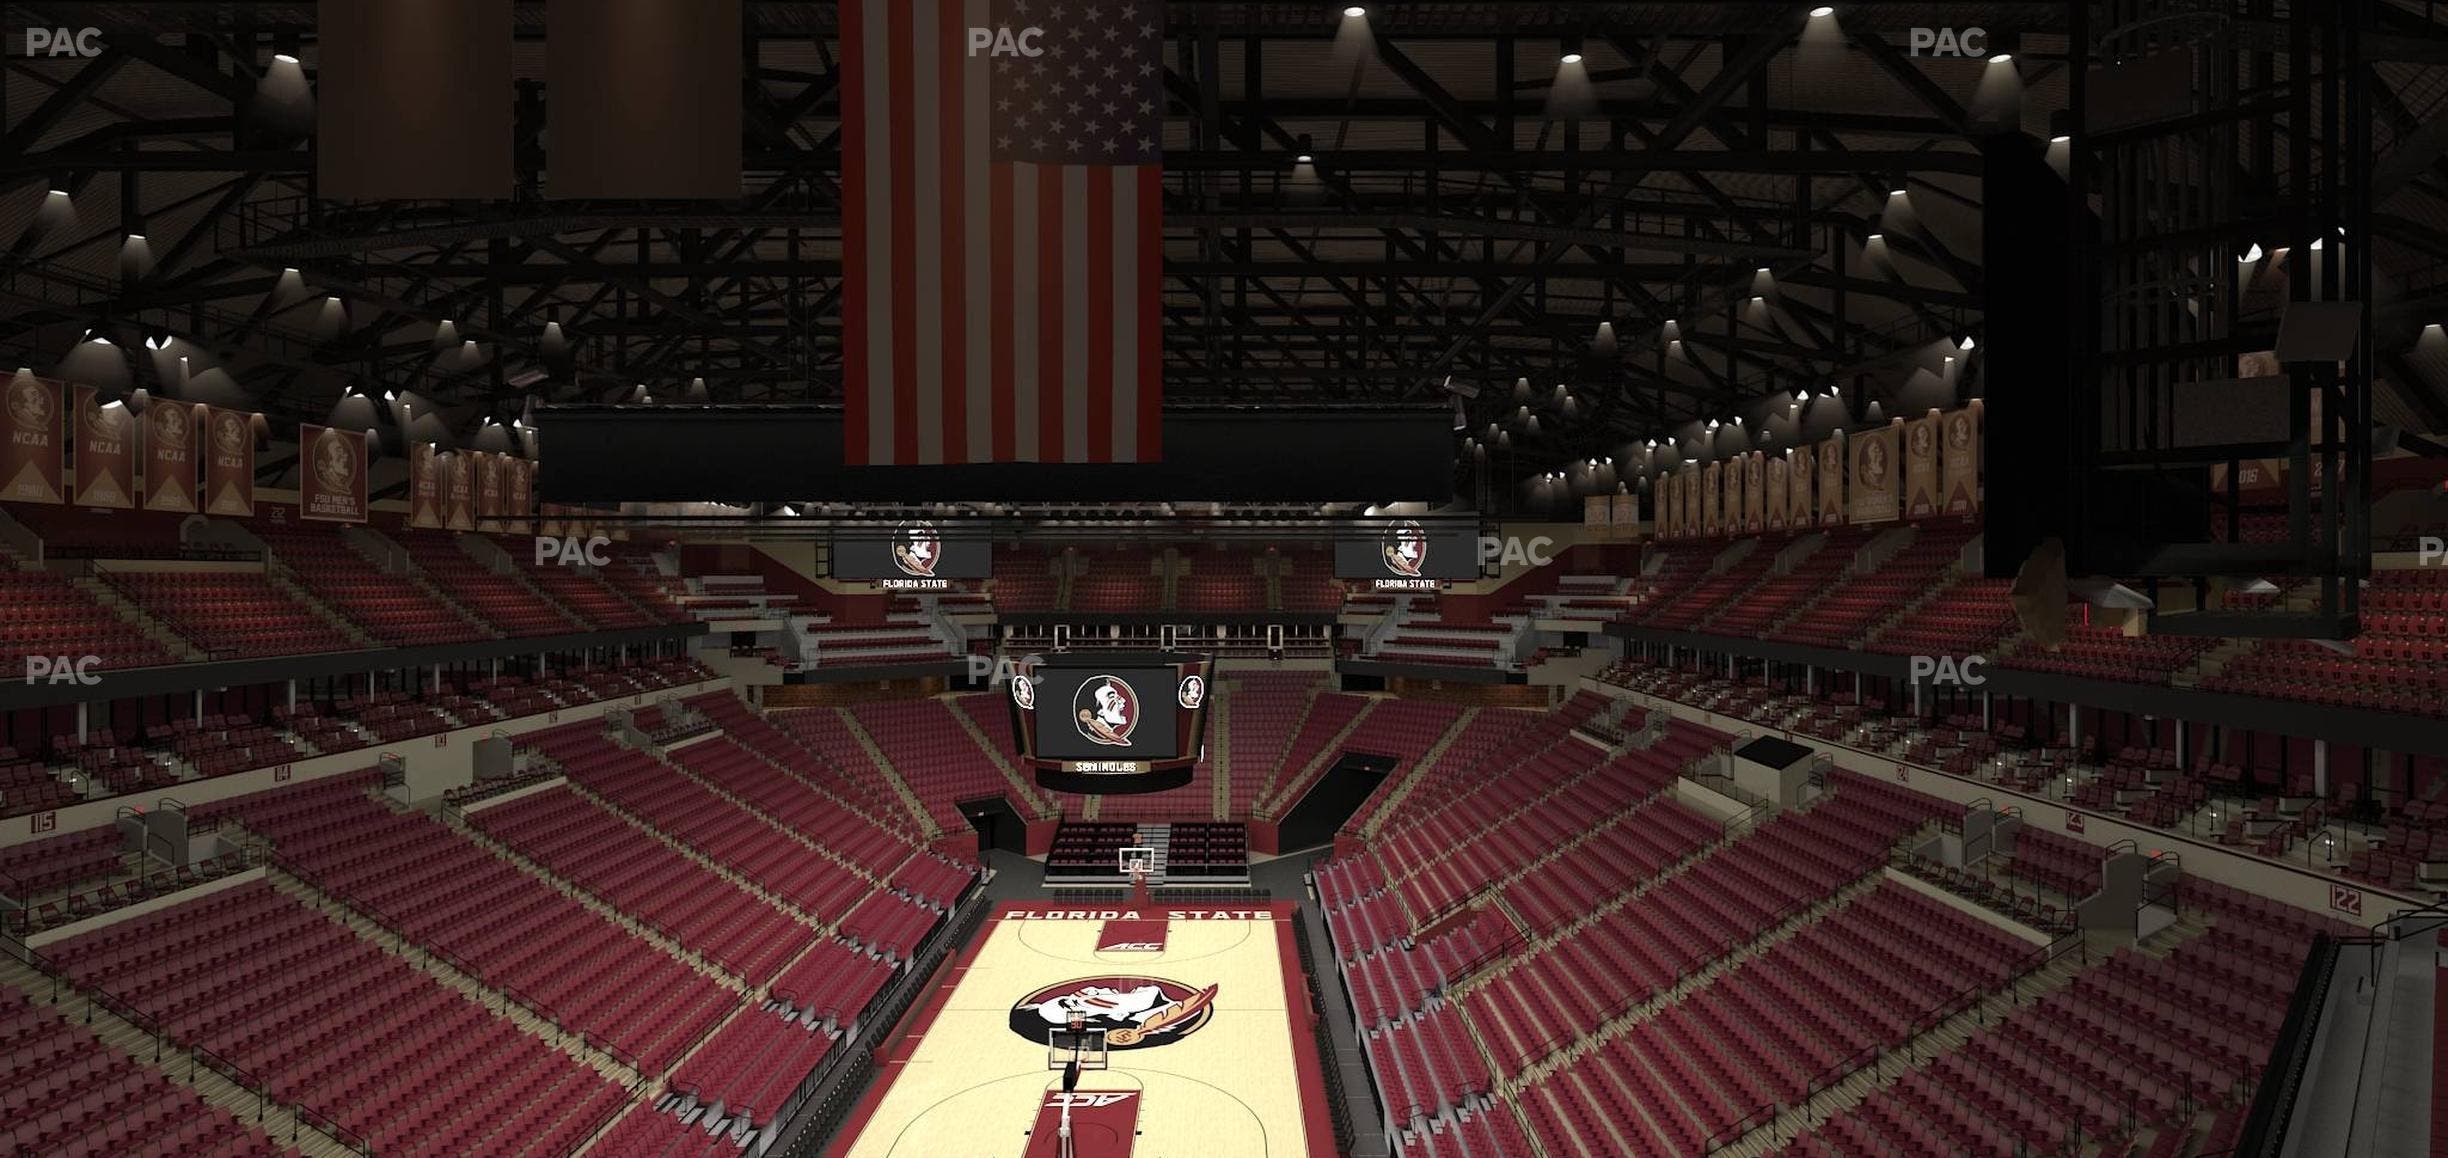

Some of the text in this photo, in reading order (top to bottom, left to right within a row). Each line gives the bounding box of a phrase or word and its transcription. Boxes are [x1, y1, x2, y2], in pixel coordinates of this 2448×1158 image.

[12, 430, 49, 447] NCAA
[89, 440, 121, 455] NCAA
[158, 449, 186, 463] NCAA
[310, 502, 360, 515] BASKETBALL
[882, 579, 948, 588] FLORIDA STATE
[1375, 579, 1436, 588] FLORIDA STATE
[1075, 762, 1137, 772] SEMINOLES
[1004, 910, 1273, 920] FLORIDA STATE
[1100, 942, 1164, 951] ACC
